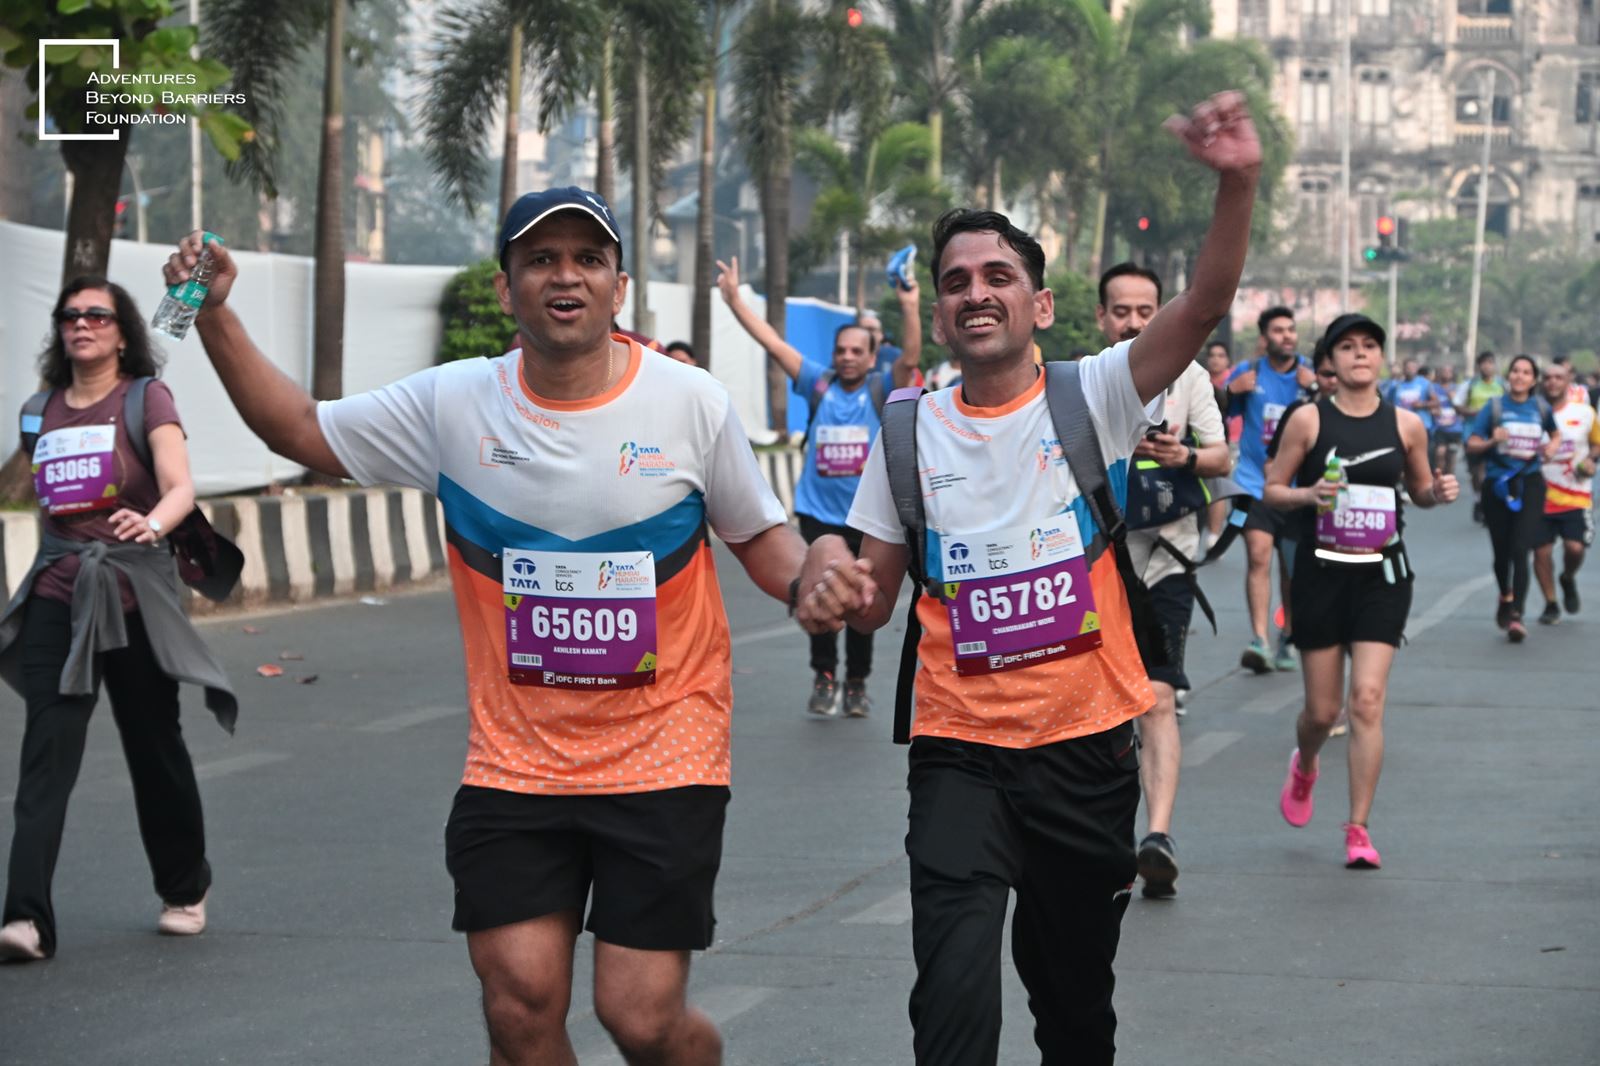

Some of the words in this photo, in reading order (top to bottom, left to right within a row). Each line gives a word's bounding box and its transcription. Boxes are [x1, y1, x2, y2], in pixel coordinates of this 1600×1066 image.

[512, 400, 560, 430] clusion
[45, 457, 102, 484] 63066
[1334, 510, 1386, 530] 62248
[1044, 528, 1060, 536] TATA
[948, 564, 976, 575] TATA
[988, 558, 1008, 570] tcs
[510, 578, 541, 590] TATA
[555, 580, 574, 592] tcs
[970, 571, 1077, 623] 65782
[532, 606, 638, 642] 65609
[992, 620, 1036, 634] CHANDRAKANT
[1038, 616, 1056, 626] MORE
[554, 646, 580, 655] AKHILESH
[1004, 654, 1023, 664] IDFC
[1024, 650, 1046, 662] FIRST
[1047, 645, 1066, 655] Bank
[556, 675, 572, 684] IDFC
[574, 677, 596, 685] FIRST
